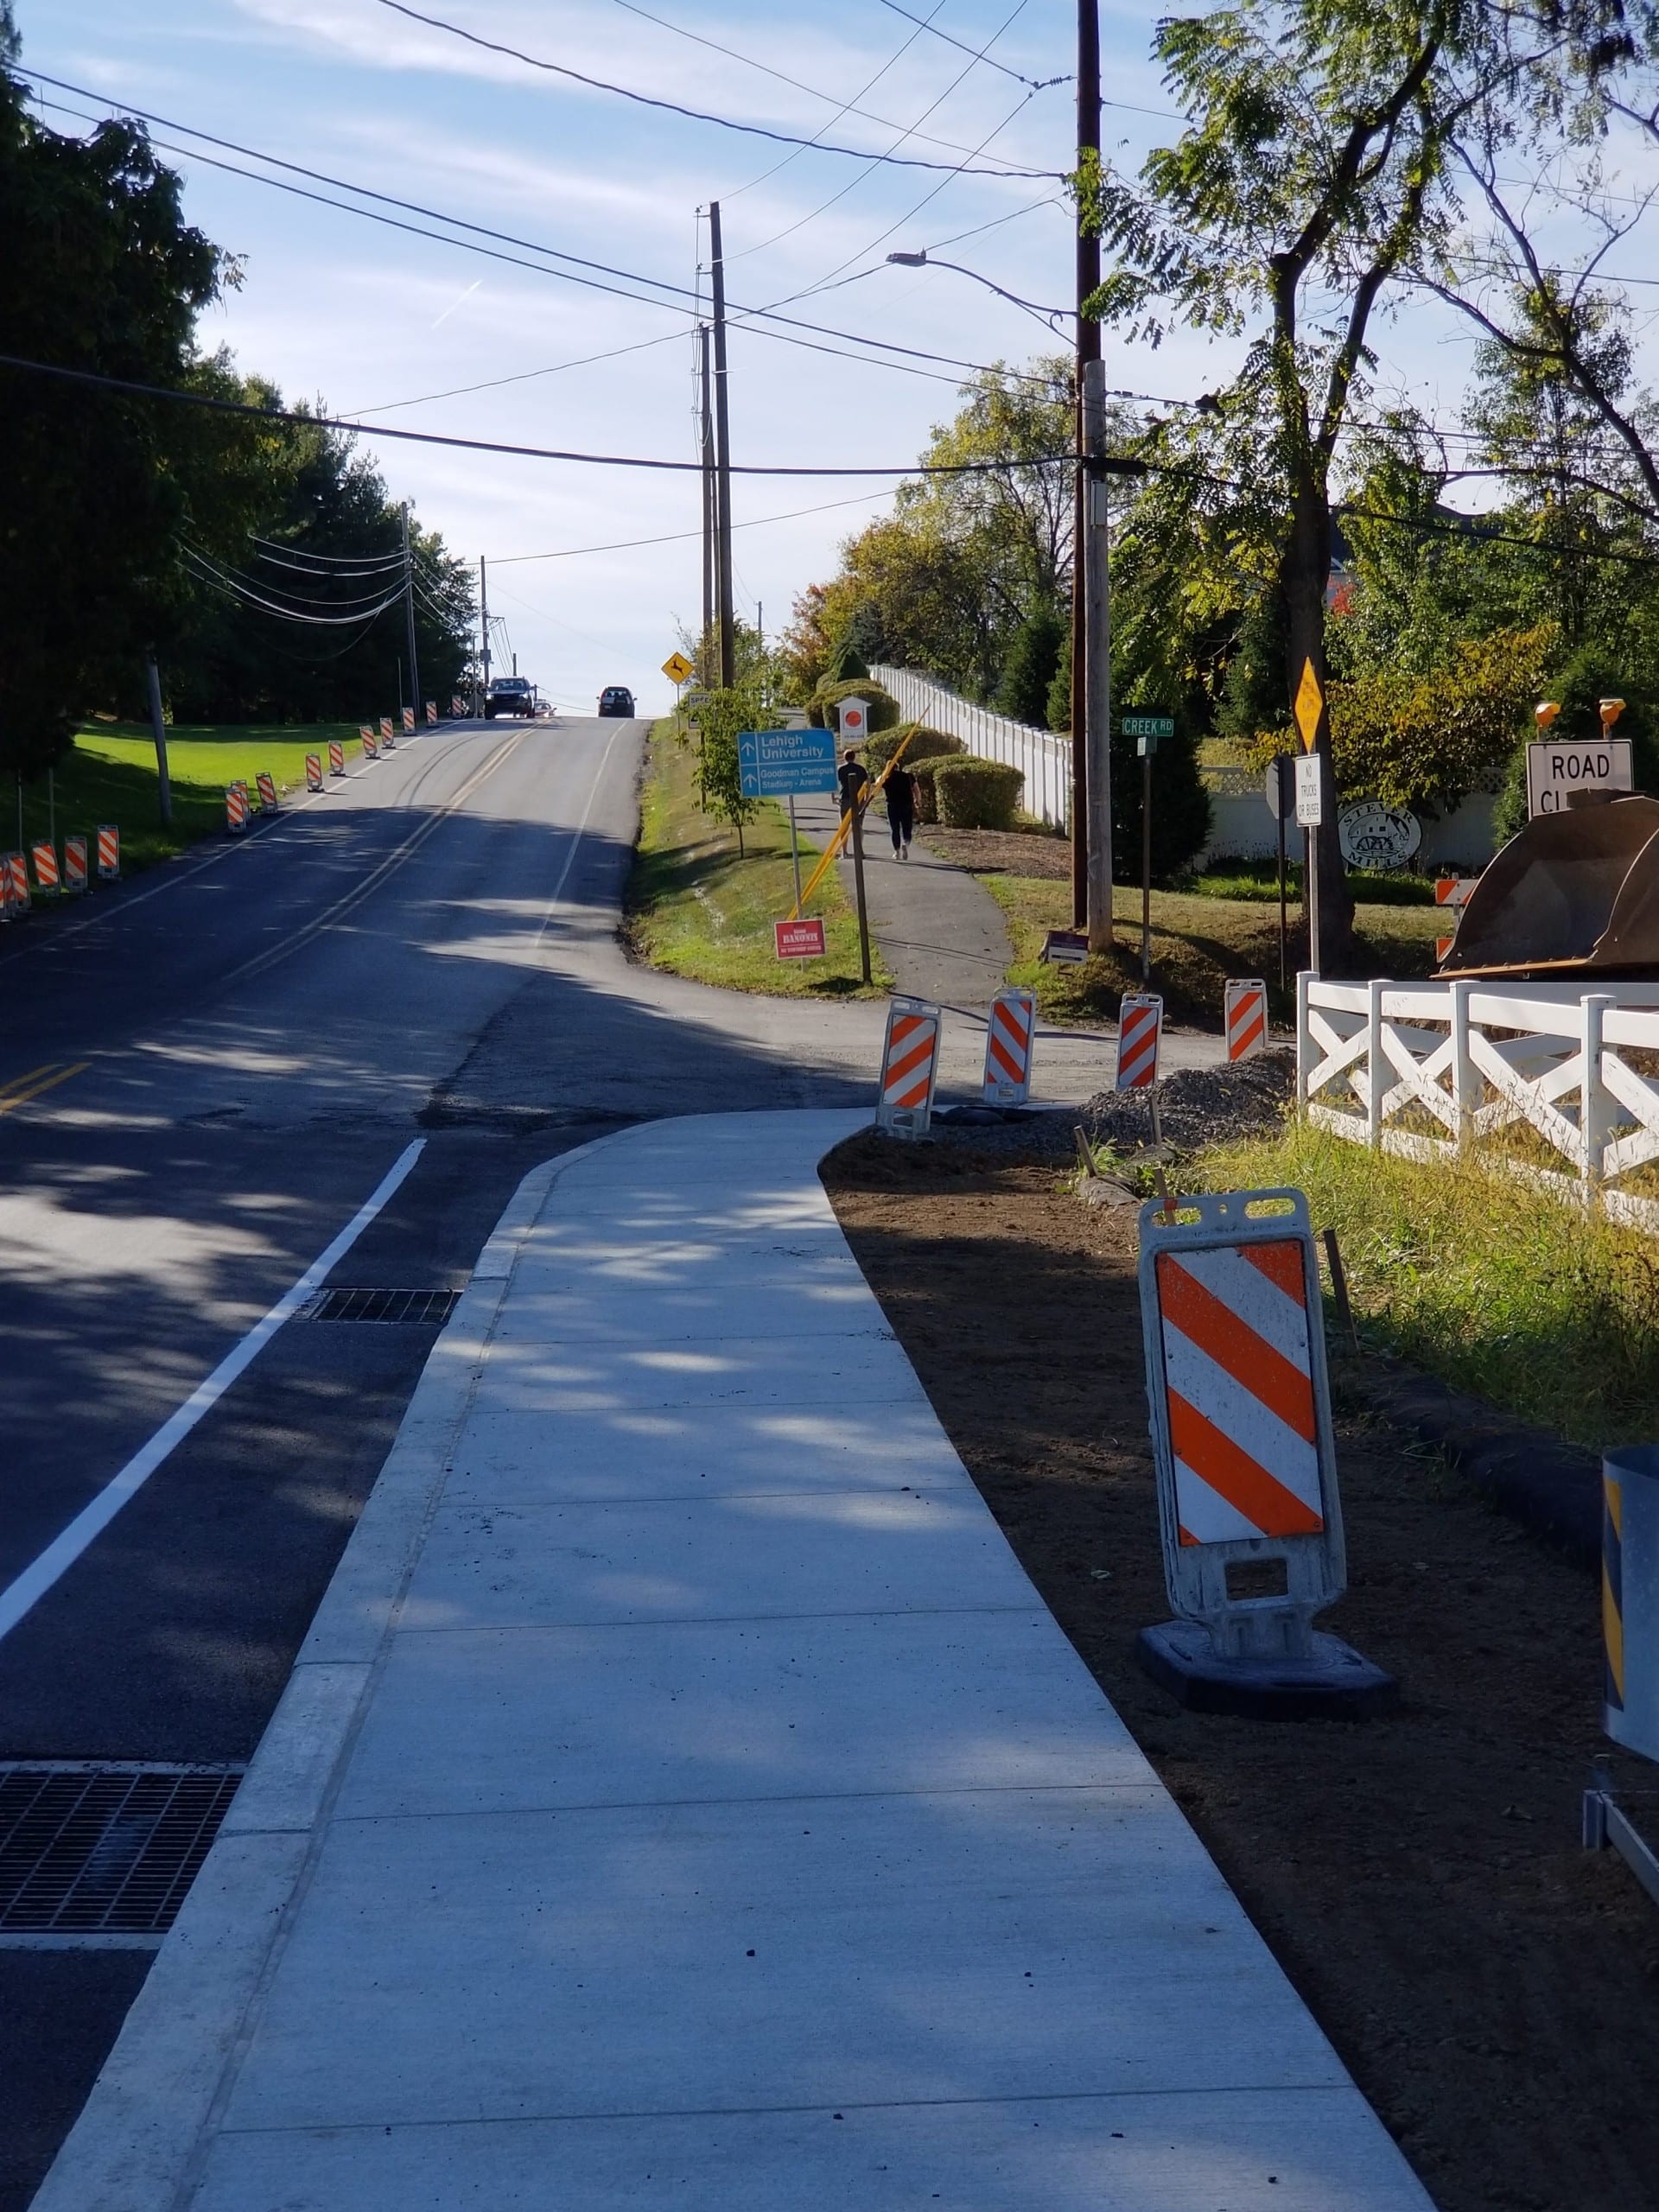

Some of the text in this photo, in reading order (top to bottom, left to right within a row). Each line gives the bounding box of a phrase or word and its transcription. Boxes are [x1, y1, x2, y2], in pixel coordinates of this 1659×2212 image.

[1124, 719, 1172, 734] CREEK RD
[761, 734, 803, 747] Lehigh
[762, 746, 823, 760] University
[760, 766, 835, 779] Goodman Campus
[1306, 763, 1313, 778] NO
[1552, 754, 1610, 779] ROAD
[762, 780, 793, 789] Stadium
[798, 779, 822, 787] Arena
[1300, 784, 1317, 798] TRUCKS
[1299, 802, 1319, 817] OR BUSES
